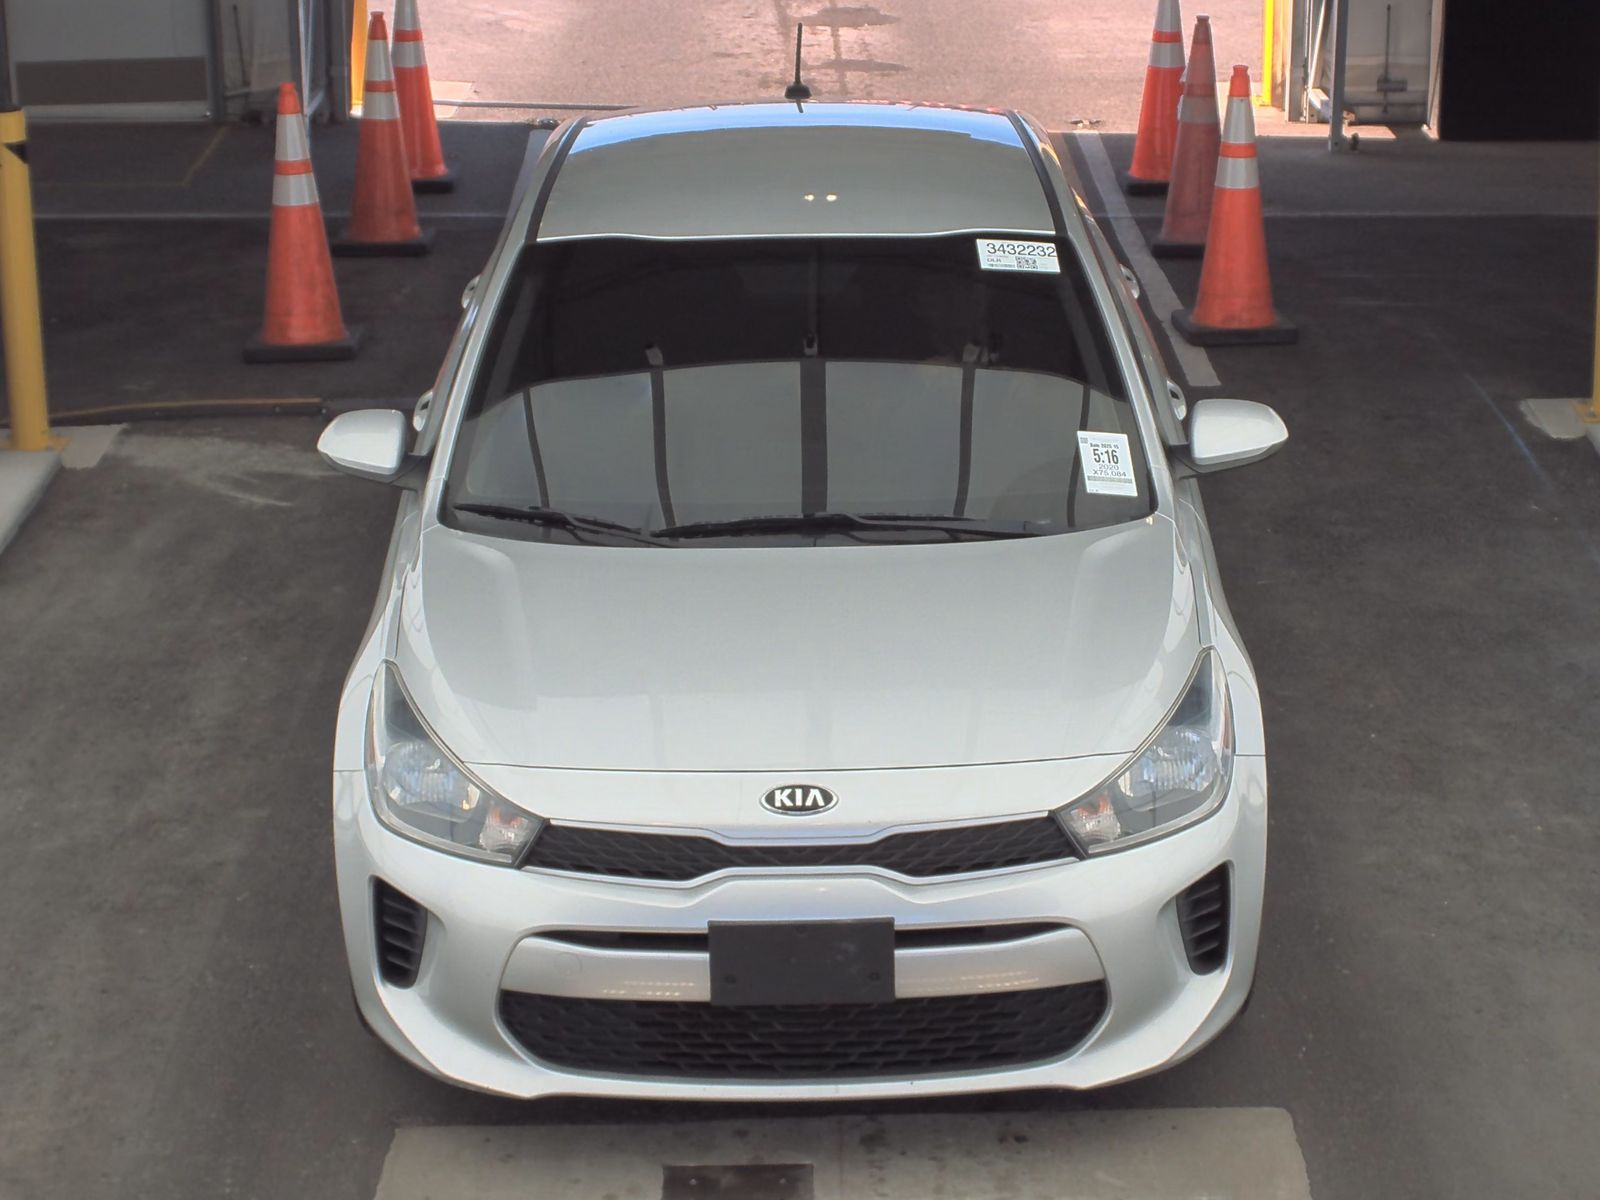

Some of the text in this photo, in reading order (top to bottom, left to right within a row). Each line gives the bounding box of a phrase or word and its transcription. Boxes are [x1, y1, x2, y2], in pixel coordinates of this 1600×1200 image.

[986, 242, 1057, 257] 3432232
[1092, 448, 1119, 464] 5:16
[774, 788, 825, 807] KIA
